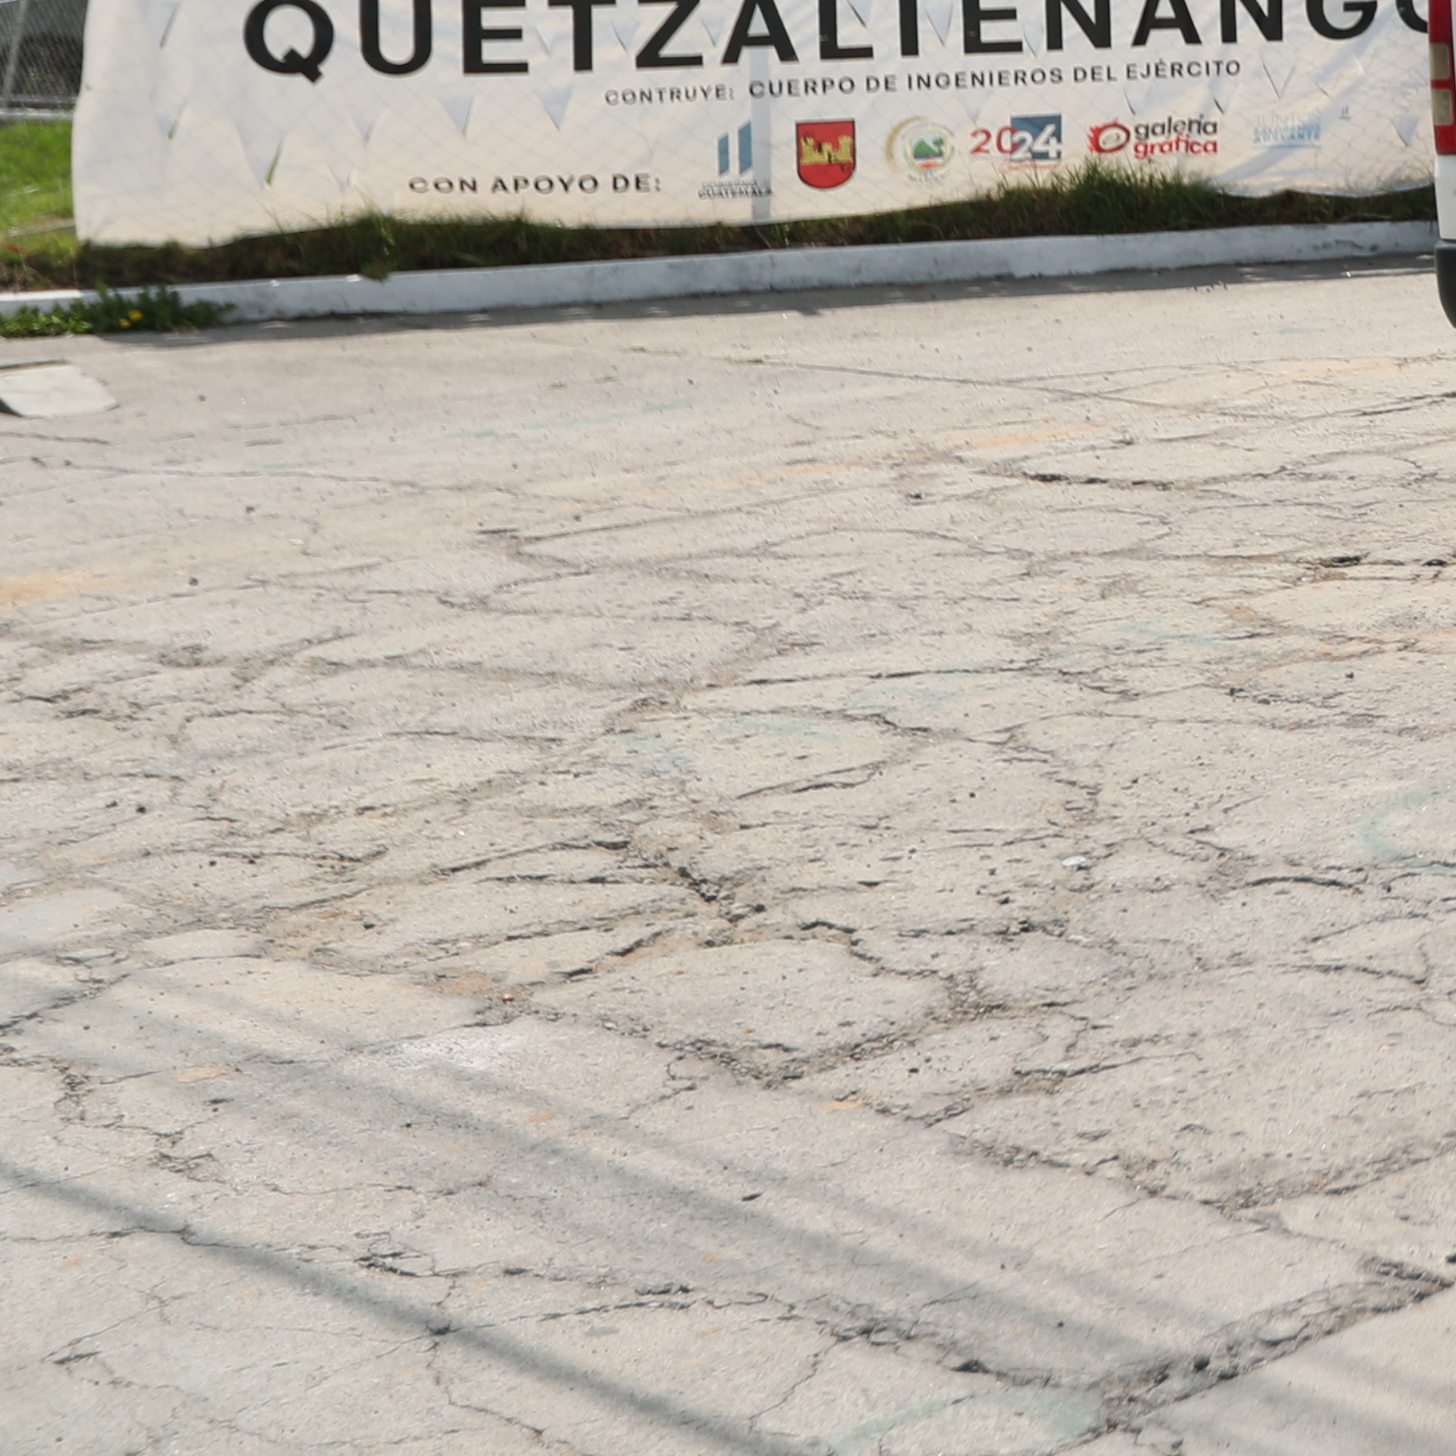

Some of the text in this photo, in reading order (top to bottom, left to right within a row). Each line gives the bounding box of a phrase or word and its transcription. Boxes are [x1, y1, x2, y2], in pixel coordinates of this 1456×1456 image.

[604, 58, 1242, 106] CONTRUYE: CUERPO DE INGENIEROS DEL EJÉRCITO
[969, 120, 1062, 160] 2024
[408, 172, 662, 194] CON APOYO DE:
